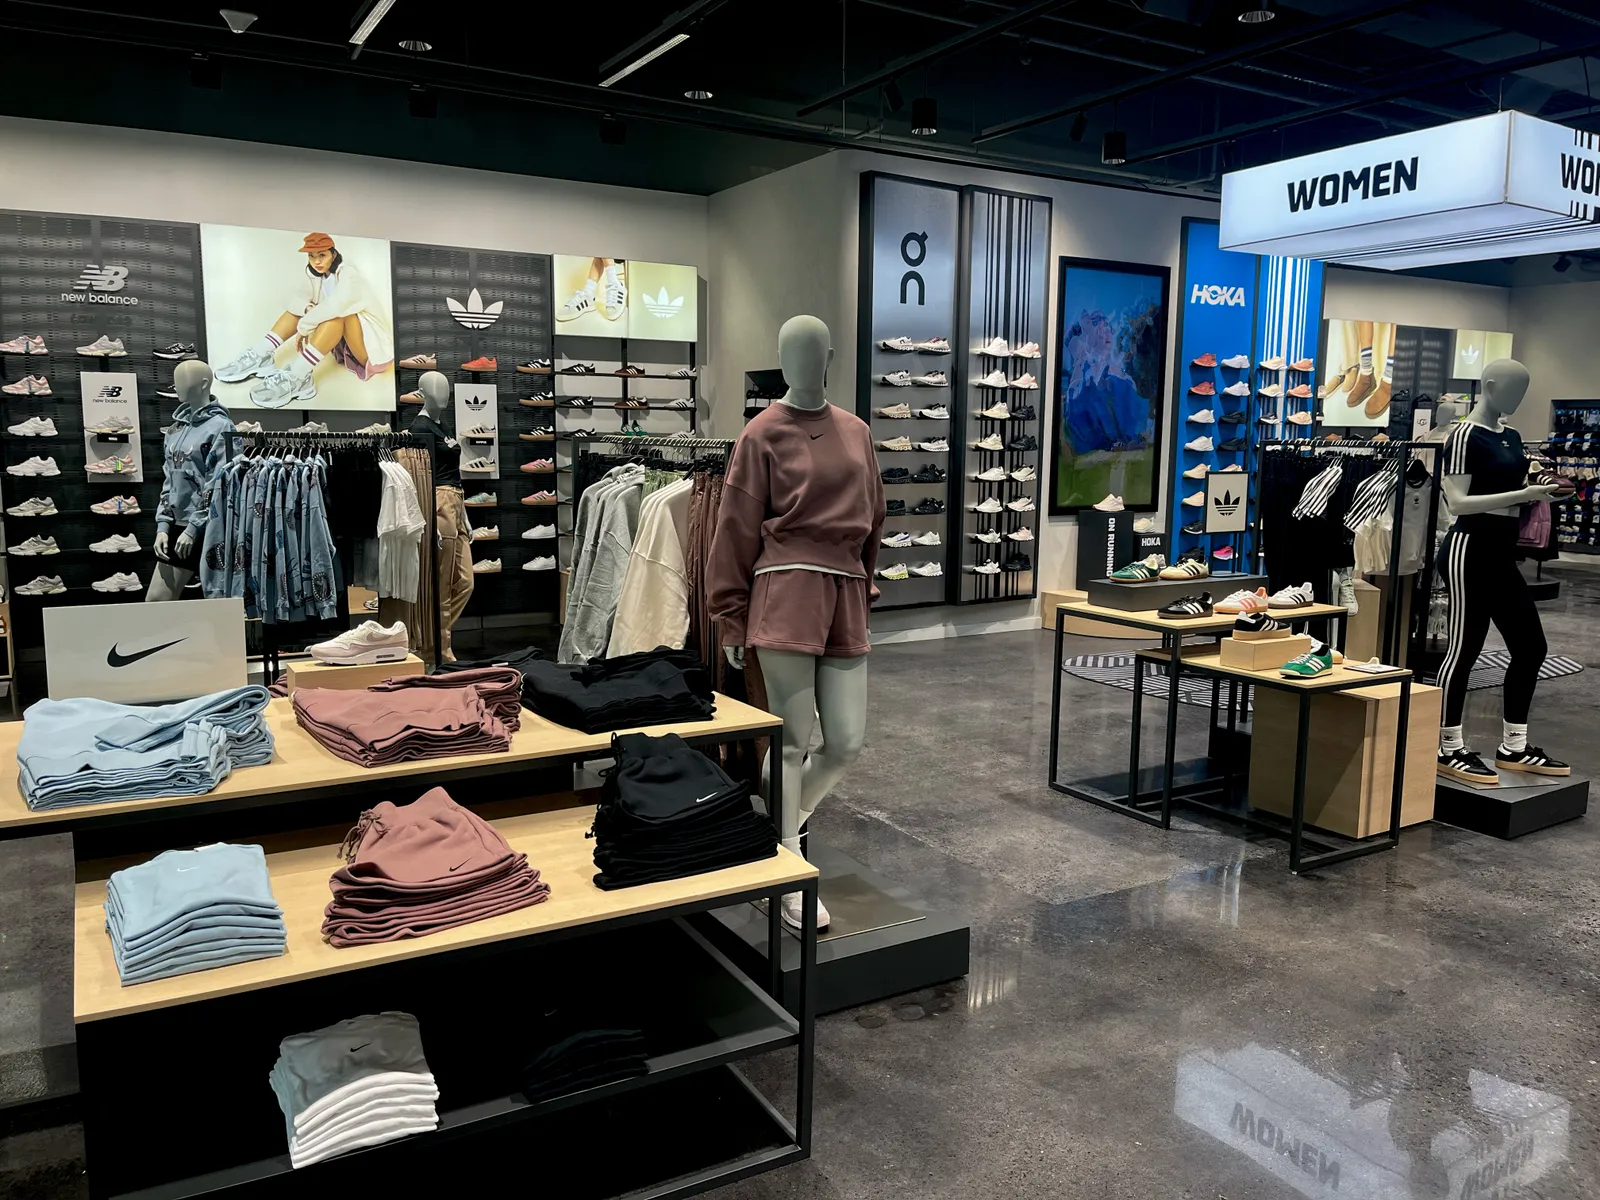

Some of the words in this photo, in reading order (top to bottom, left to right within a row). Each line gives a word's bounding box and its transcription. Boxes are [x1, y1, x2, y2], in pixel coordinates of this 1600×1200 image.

[1560, 152, 1600, 197] WO
[1287, 156, 1419, 213] WOMEN
[61, 293, 86, 302] new
[88, 293, 139, 305] balance
[1190, 283, 1246, 307] HOKA
[1107, 517, 1116, 532] ON
[1141, 537, 1161, 547] HOKA
